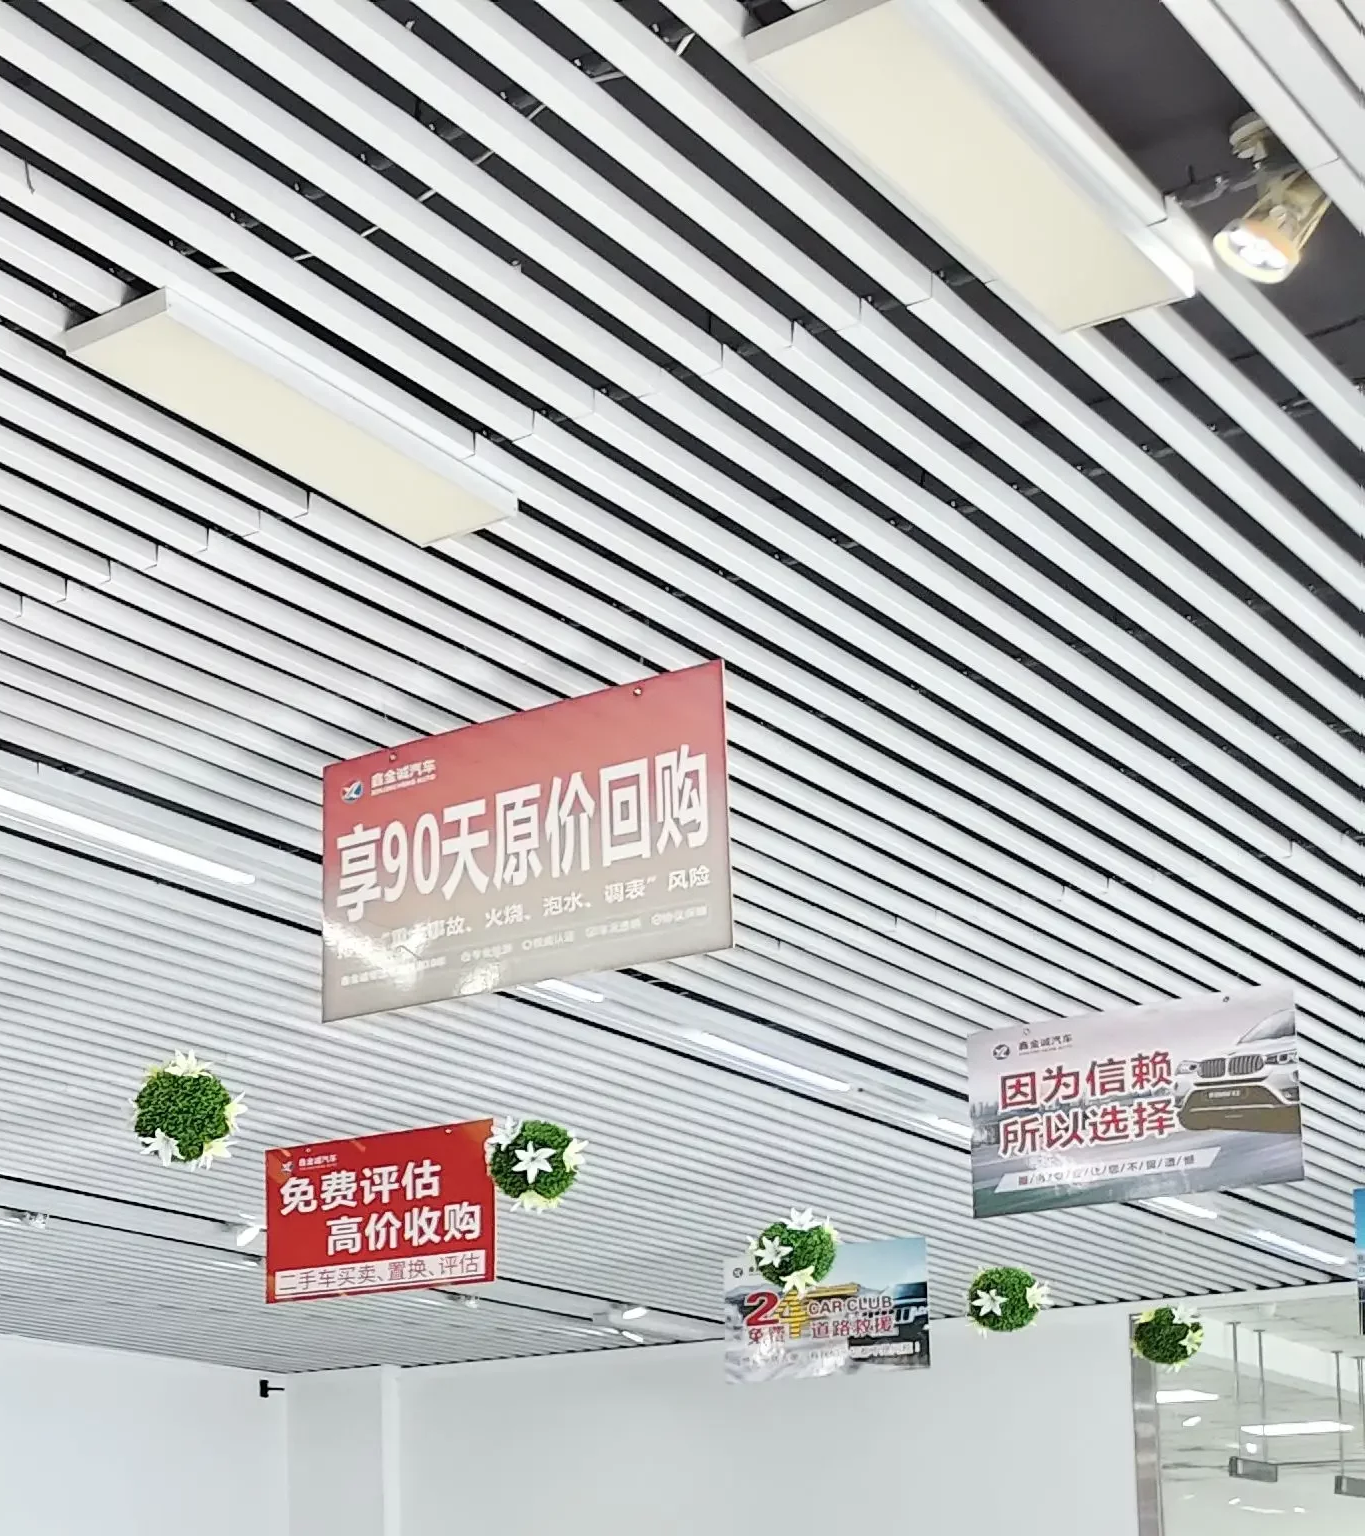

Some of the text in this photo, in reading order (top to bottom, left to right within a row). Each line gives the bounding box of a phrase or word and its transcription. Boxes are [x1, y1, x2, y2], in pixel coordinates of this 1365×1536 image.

[335, 744, 710, 923] 享90天原价回购
[667, 863, 711, 892] 风险
[999, 1051, 1173, 1111] 因为信赖
[1000, 1099, 1176, 1158] 所以选择
[279, 1158, 442, 1216] 免费评估
[326, 1201, 483, 1256] 高价收购
[278, 1254, 481, 1291] 二手车买卖、置换、评估
[808, 1296, 893, 1315] CAR CLUB
